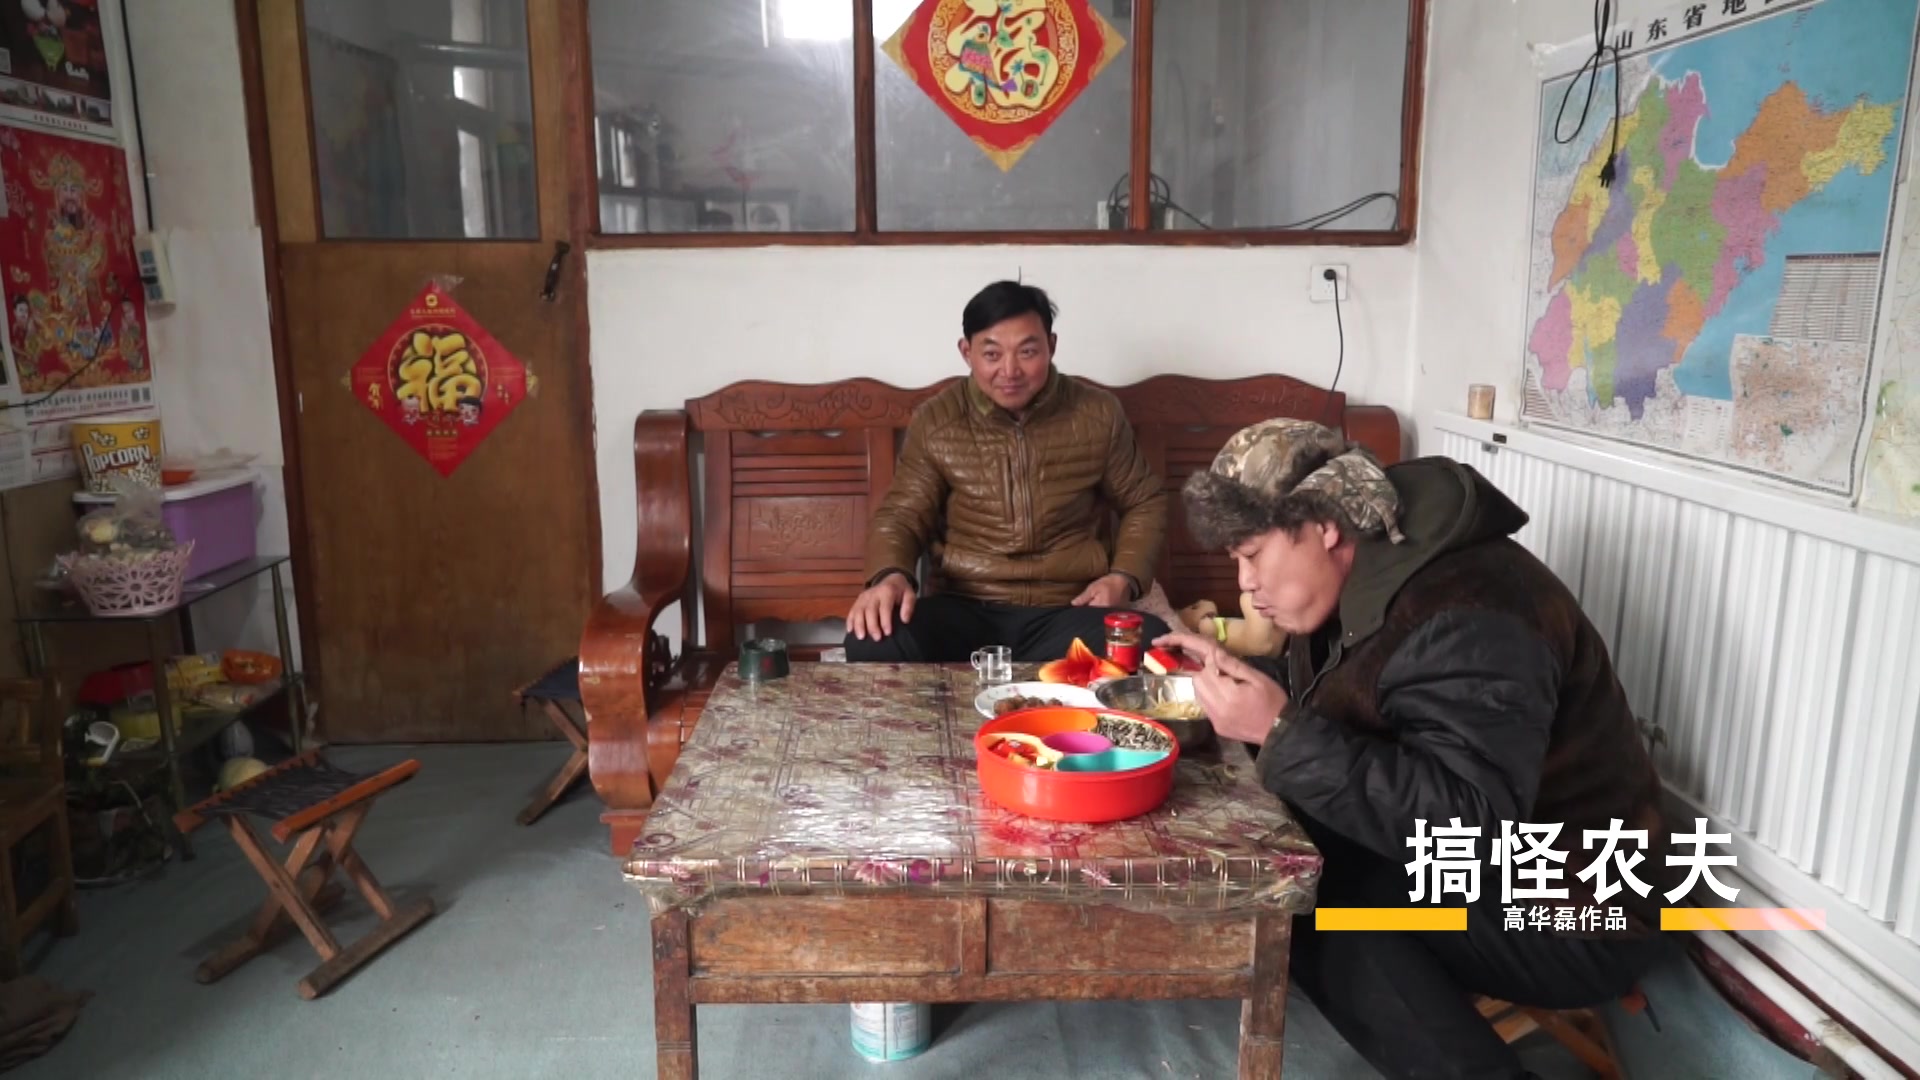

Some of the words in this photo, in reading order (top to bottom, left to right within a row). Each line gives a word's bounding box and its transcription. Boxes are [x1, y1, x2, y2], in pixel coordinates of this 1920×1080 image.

[1615, 0, 1775, 50] 山东省地
[397, 332, 482, 413] 福
[82, 443, 149, 474] POPCORN
